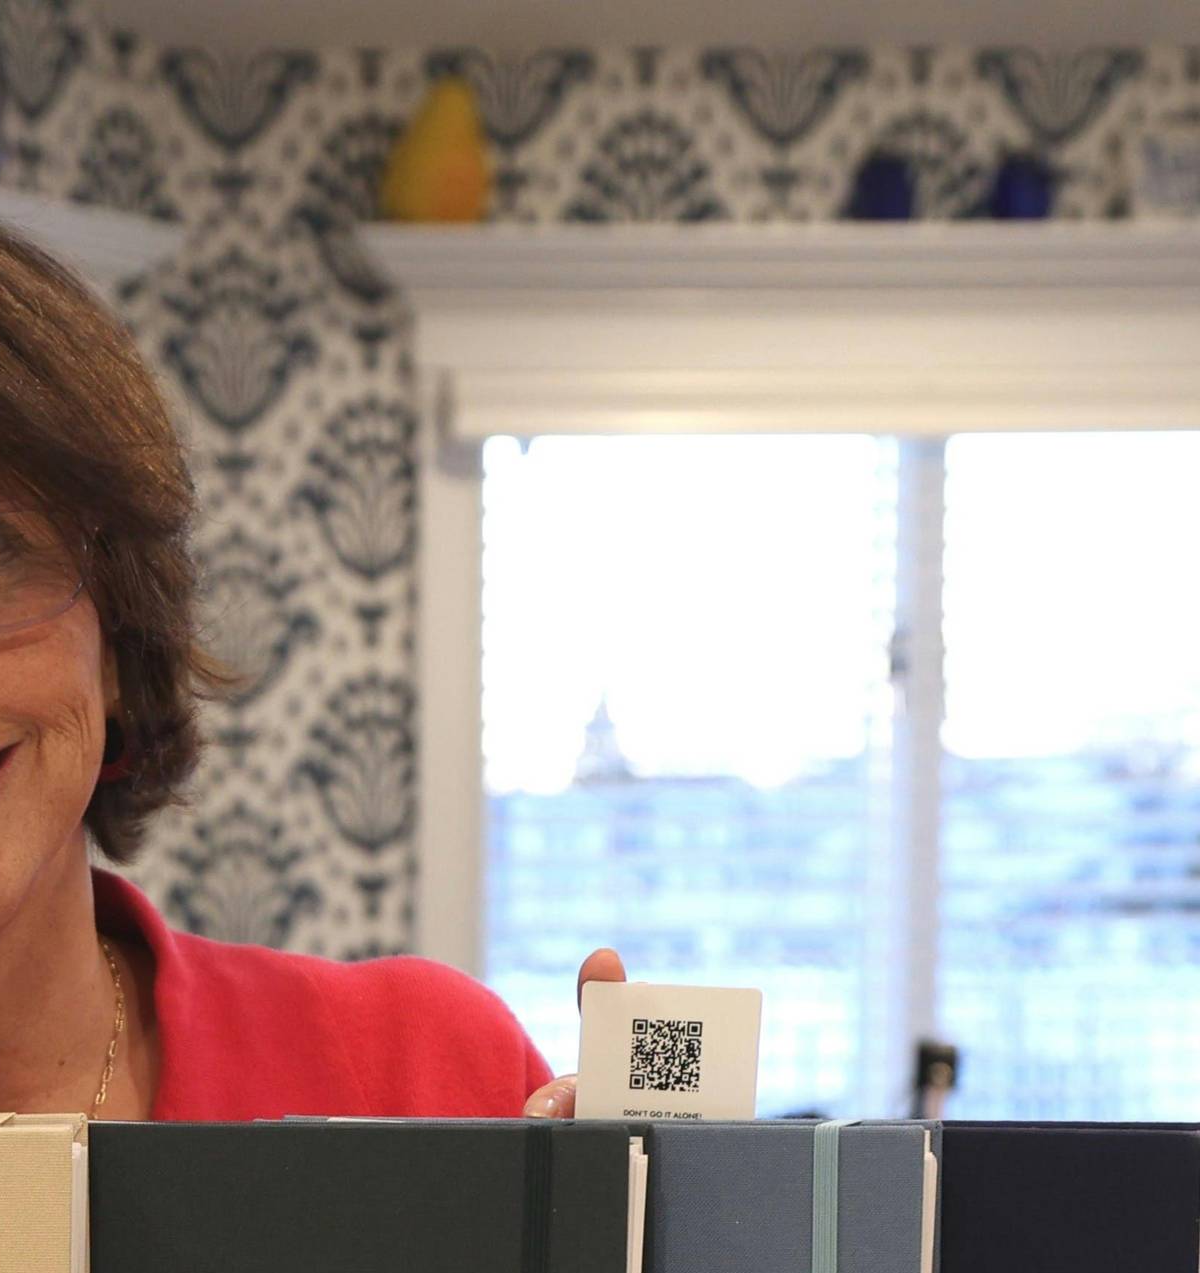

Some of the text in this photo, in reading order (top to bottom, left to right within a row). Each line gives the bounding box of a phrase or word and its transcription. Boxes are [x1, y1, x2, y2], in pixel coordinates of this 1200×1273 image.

[623, 1109, 648, 1118] DON'T
[665, 1111, 671, 1119] IT
[674, 1112, 702, 1120] ALONE!
